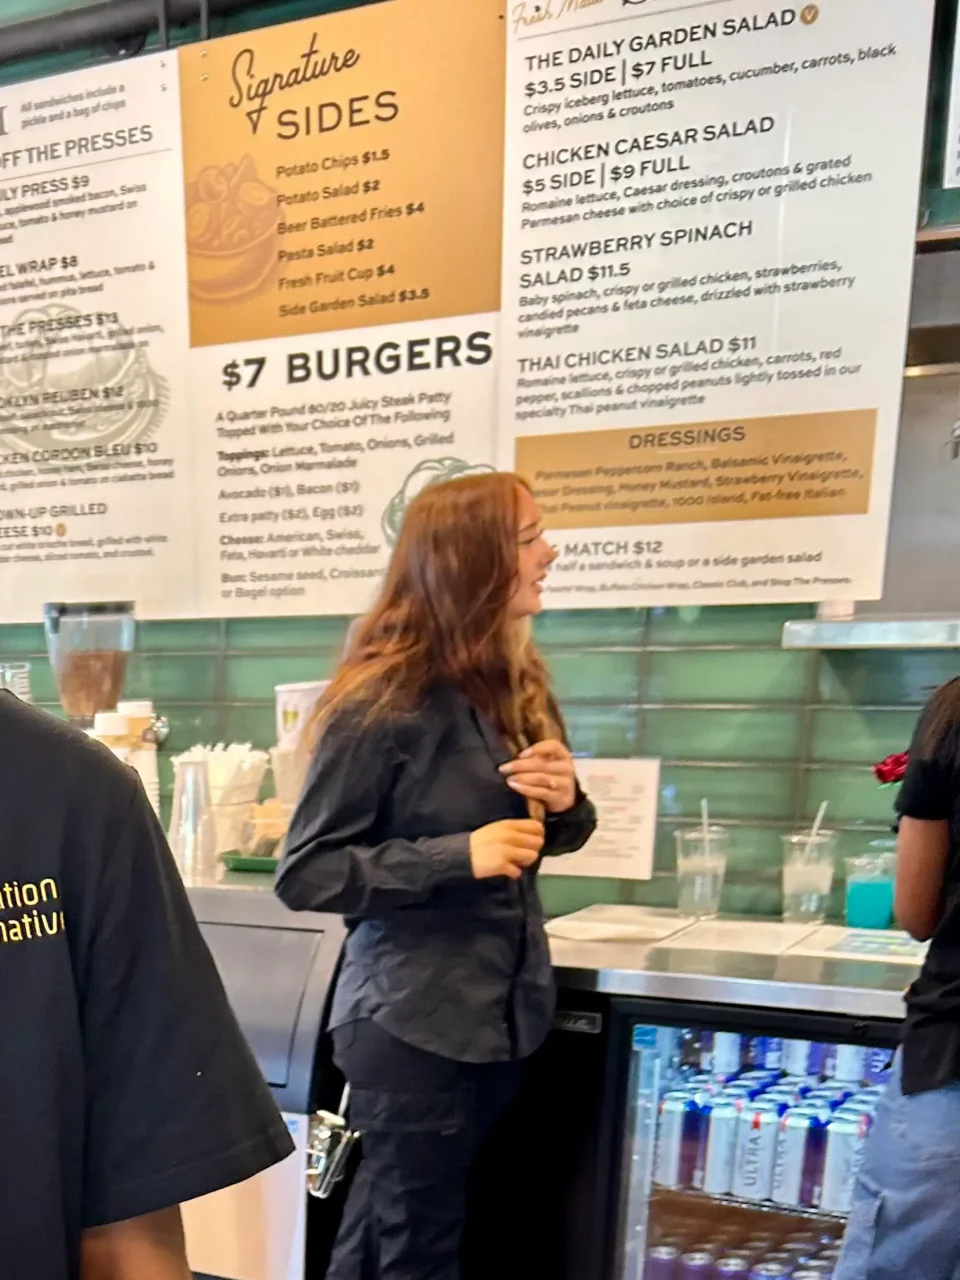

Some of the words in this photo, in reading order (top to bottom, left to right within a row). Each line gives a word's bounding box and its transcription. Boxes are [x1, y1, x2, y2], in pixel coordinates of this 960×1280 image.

[525, 51, 563, 70] THE
[569, 39, 624, 63] DAILY
[629, 23, 717, 52] GARDEN
[723, 10, 796, 36] SALAD
[229, 32, 360, 134] Signature
[524, 103, 561, 116] Crispy
[565, 94, 609, 108] iceberg
[612, 86, 658, 100] lettuce,
[662, 75, 726, 92] tomatoes,
[729, 62, 798, 81] cucumber,
[801, 53, 854, 69] carrots,
[858, 44, 896, 60] black
[525, 77, 565, 98] $3.5
[570, 66, 616, 88] SIDE
[632, 61, 656, 79] $7
[661, 51, 712, 72] FULL
[277, 90, 399, 139] SIDES
[523, 120, 561, 133] olives,
[564, 112, 604, 126] onions
[607, 108, 616, 119] &
[619, 100, 674, 117] croutons
[25, 142, 60, 164] THE
[65, 125, 153, 157] PRESSES
[523, 143, 609, 169] CHICKEN
[615, 128, 698, 155] CAESAR
[703, 117, 774, 141] SALAD
[276, 163, 319, 178] Potato
[322, 154, 358, 170] Chips
[362, 149, 390, 164] $1.5
[523, 179, 545, 195] $5
[550, 169, 595, 190] SIDE
[611, 165, 635, 182] $9
[640, 156, 690, 176] FULL
[21, 177, 68, 198] PRESS
[72, 175, 90, 189] $9
[276, 190, 319, 207] Potato
[322, 181, 359, 199] Salad
[363, 179, 380, 194] $2
[522, 198, 573, 211] Romaine
[576, 191, 620, 204] lettuce,
[623, 184, 667, 198] Caesar
[670, 176, 729, 191] dressing,
[732, 167, 790, 183] croutons
[793, 163, 802, 174] &
[806, 155, 851, 175] grated
[521, 214, 580, 228] Parmesan
[583, 207, 625, 220] cheese
[629, 202, 654, 213] with
[656, 197, 697, 210] choice
[700, 191, 714, 204] of
[716, 190, 755, 202] crispy
[758, 186, 772, 196] or
[774, 178, 817, 197] grilled
[819, 173, 872, 188] chicken
[277, 221, 307, 235] Beer
[311, 208, 367, 230] Battered
[370, 205, 402, 220] Fries
[406, 202, 425, 215] $4
[278, 248, 314, 262] Pasta
[317, 239, 353, 257] Salad
[357, 238, 374, 252] $2
[521, 233, 655, 265] STRAWBERRY
[660, 221, 752, 246] SPINACH
[16, 258, 58, 275] WRAP
[278, 274, 312, 290] Fresh
[316, 270, 344, 285] Fruit
[347, 267, 373, 281] Cup
[376, 264, 394, 277] $4
[520, 267, 583, 289] SALAD
[588, 263, 630, 281] $11.5
[518, 308, 564, 323] candied
[566, 305, 609, 319] pecans
[611, 302, 620, 312] &
[624, 300, 647, 310] feta
[650, 295, 698, 307] cheese,
[701, 286, 751, 302] drizzled
[754, 283, 781, 295] with
[784, 277, 855, 292] strawberry
[519, 295, 549, 307] Baby
[552, 288, 601, 304] spinach,
[603, 286, 639, 297] crispy
[642, 283, 655, 292] or
[657, 276, 697, 293] grilled
[699, 272, 752, 285] chicken,
[755, 261, 841, 278] strawberries,
[279, 304, 306, 317] Side
[309, 297, 355, 313] Garden
[358, 291, 395, 307] Salad
[398, 288, 430, 302] $3.5
[0, 323, 25, 336] THE
[29, 314, 92, 333] PRESSES
[518, 324, 579, 339] vinaigrette
[221, 356, 267, 391] $7
[286, 331, 493, 384] BURGERS
[517, 356, 560, 372] THAI
[564, 346, 651, 368] CHICKEN
[656, 339, 724, 359] SALAD
[729, 337, 756, 353] $11
[517, 377, 567, 388] Romaine
[569, 372, 613, 383] lettuce,
[615, 369, 652, 379] crispy
[654, 366, 667, 376] or
[669, 361, 708, 377] grilled
[711, 357, 763, 370] chicken,
[766, 352, 816, 365] carrots,
[820, 348, 842, 359] red
[216, 412, 224, 422] A
[226, 409, 268, 422] Quarter
[270, 404, 305, 417] Pound
[349, 398, 379, 411] Juicy
[381, 395, 415, 407] Steak
[630, 426, 746, 449] DRESSINGS
[50, 503, 108, 517] GRILLED
[565, 541, 628, 556] MATCH
[634, 541, 662, 555] $12
